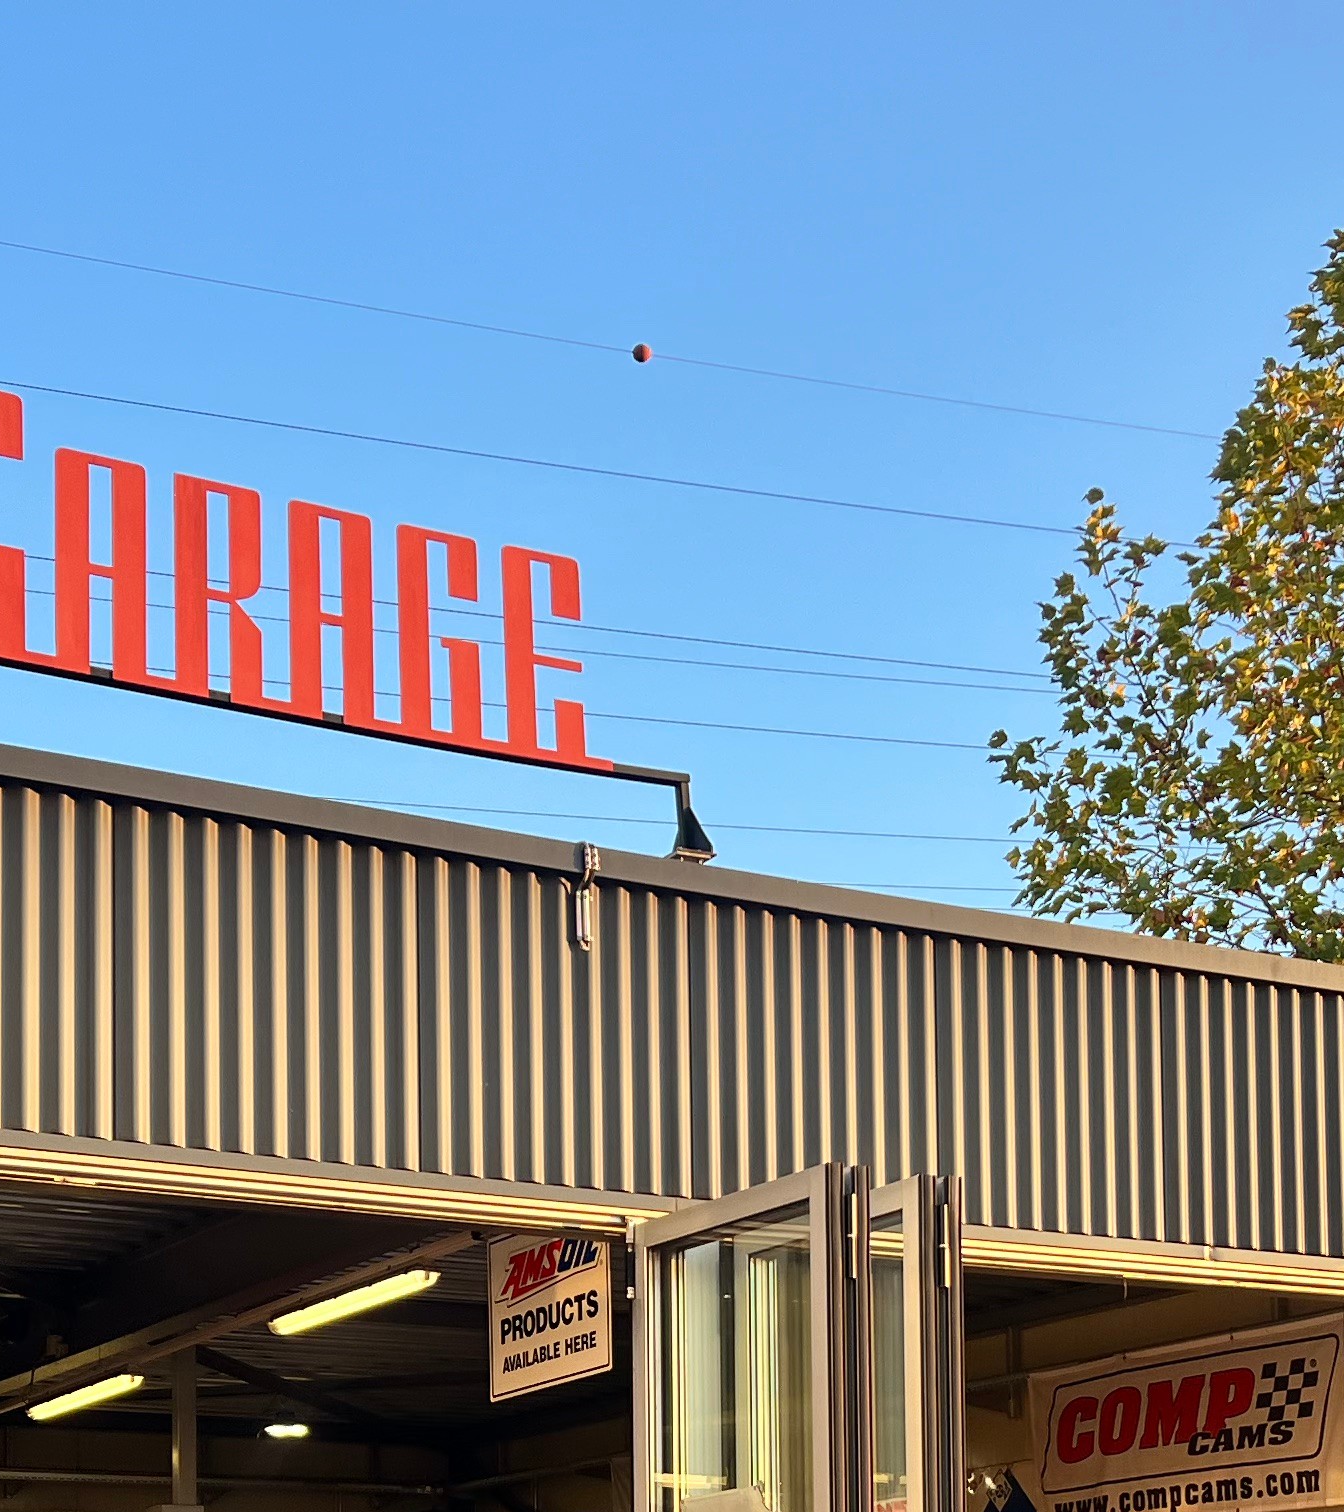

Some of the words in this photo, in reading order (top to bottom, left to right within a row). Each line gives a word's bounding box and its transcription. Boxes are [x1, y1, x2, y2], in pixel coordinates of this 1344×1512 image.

[499, 1238, 601, 1301] AMSOIL
[500, 1290, 599, 1344] PRODUCTS
[503, 1341, 560, 1374] AVAILABLE
[565, 1331, 597, 1355] HERE
[1056, 1367, 1256, 1465] COMP
[1187, 1420, 1296, 1457] CAMS
